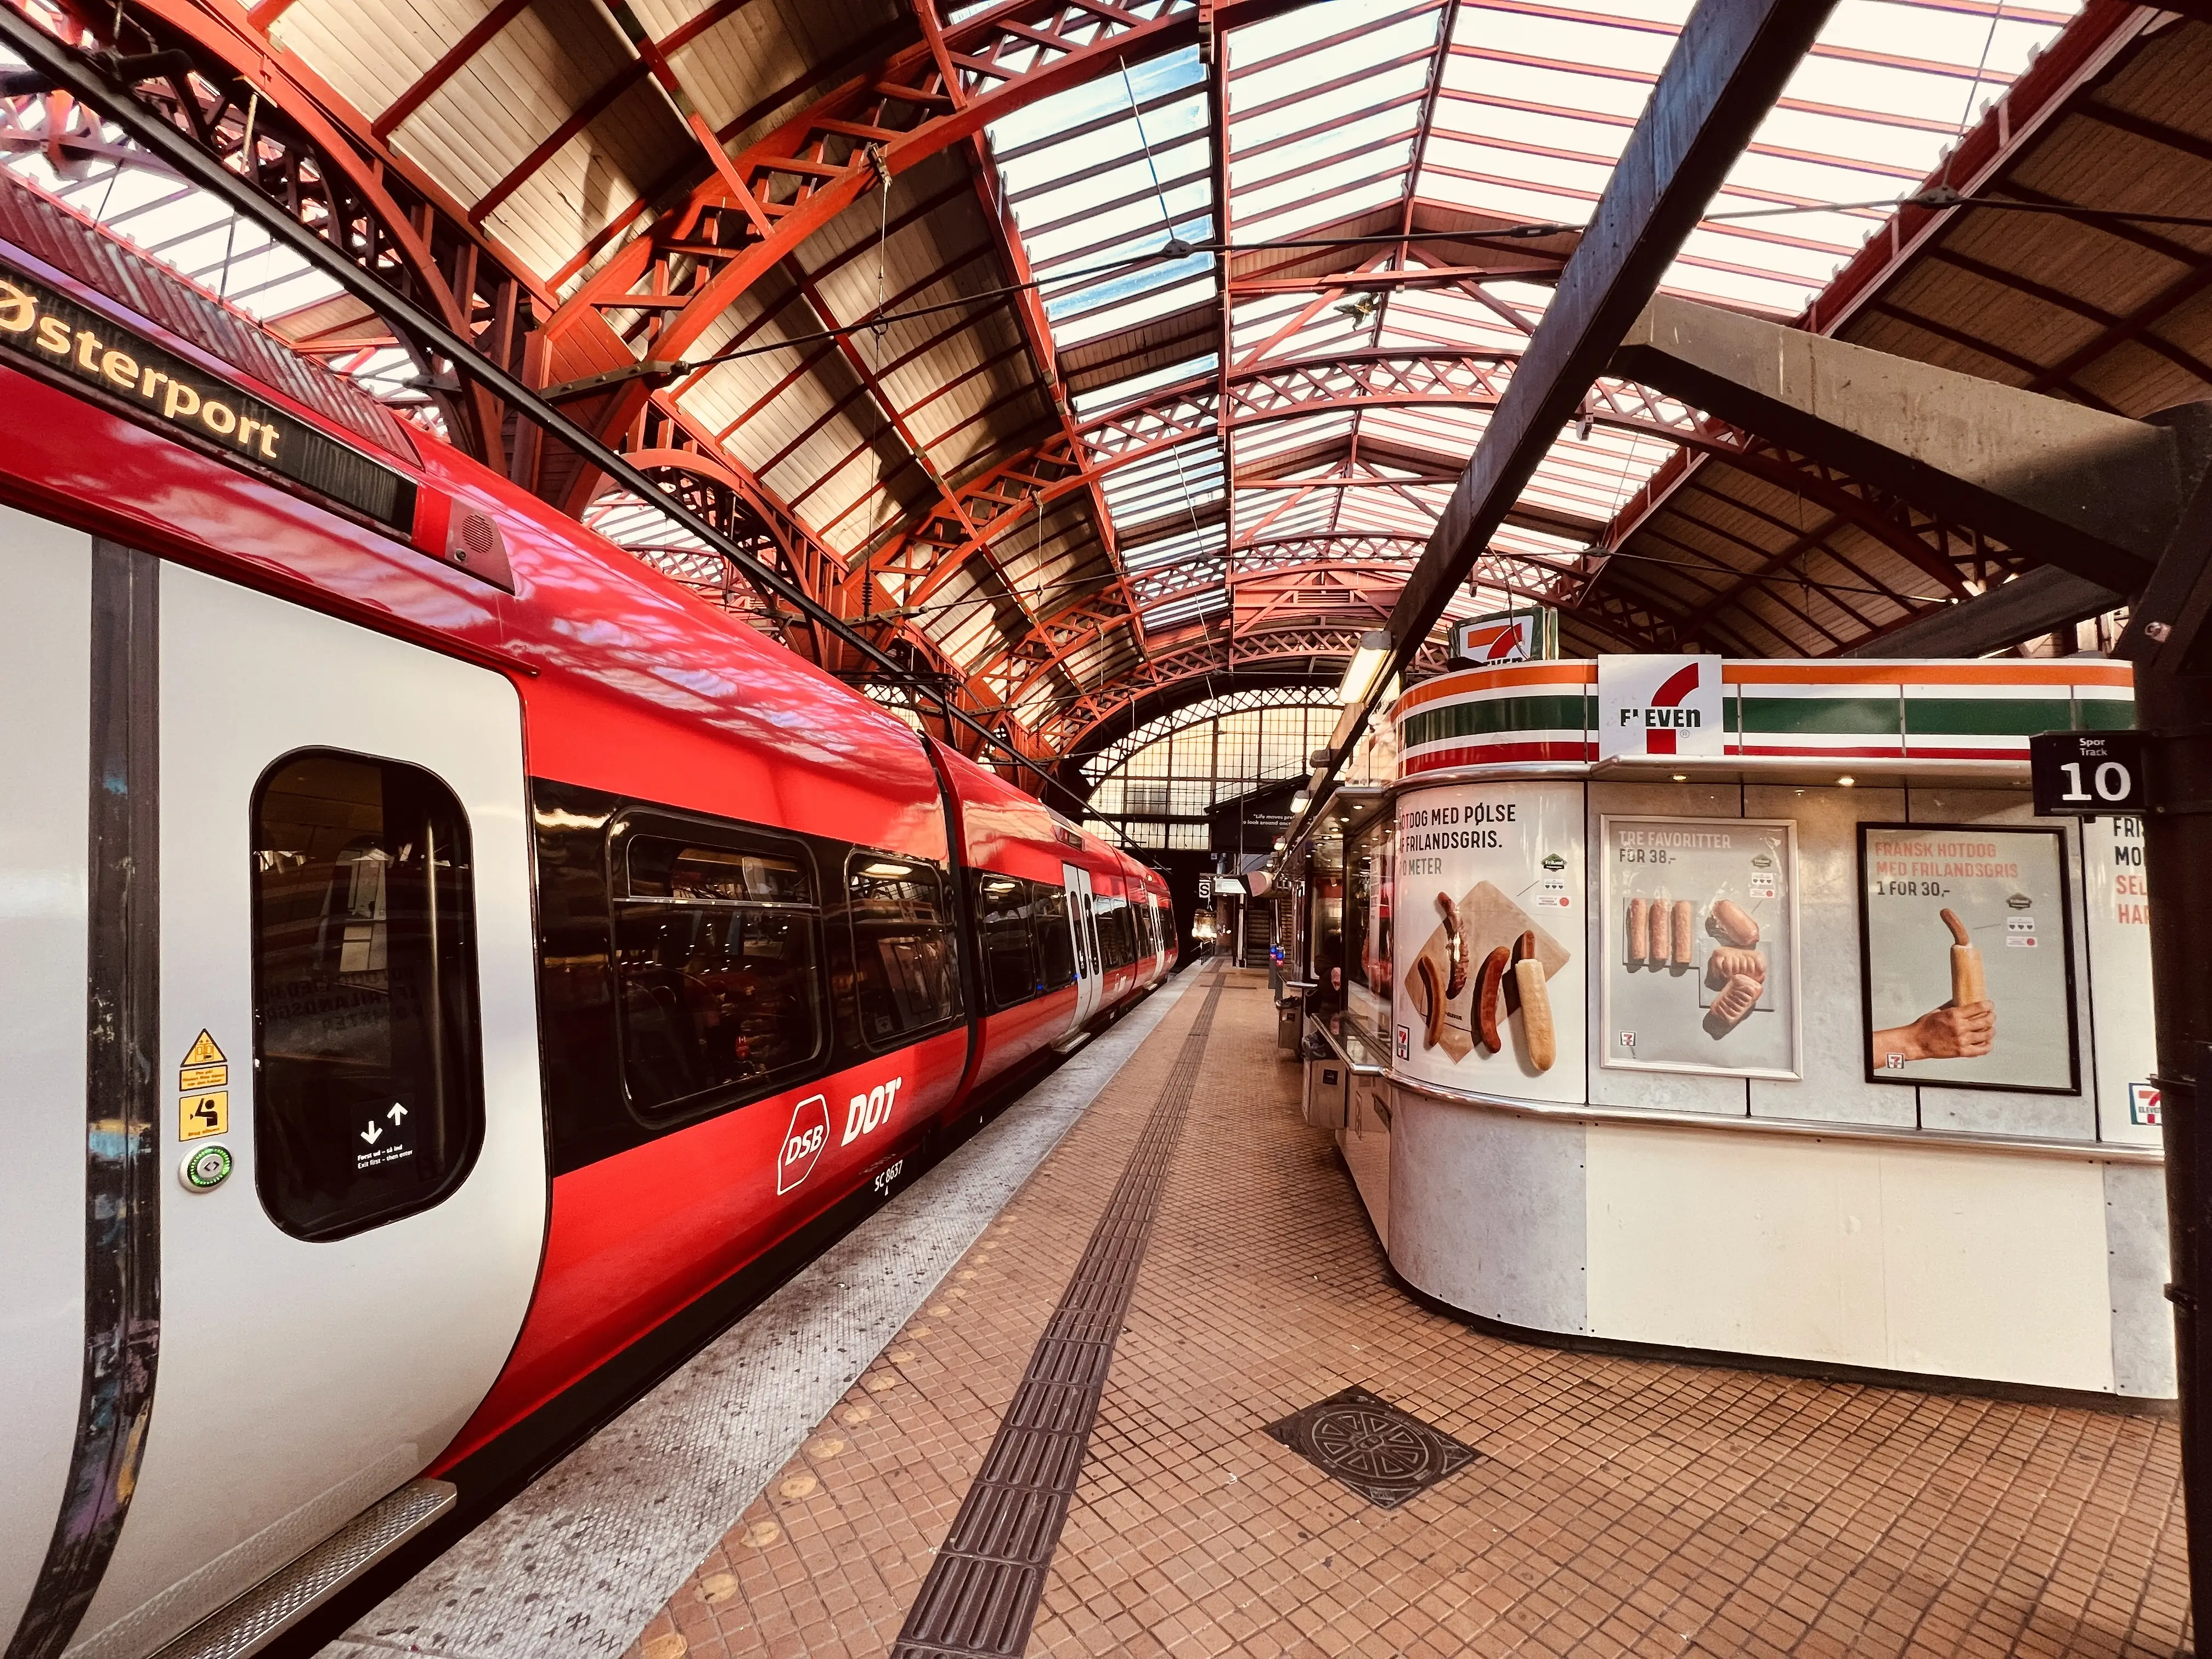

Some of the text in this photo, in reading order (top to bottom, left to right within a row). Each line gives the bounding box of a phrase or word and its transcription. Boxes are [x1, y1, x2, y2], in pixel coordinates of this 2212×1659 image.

[2079, 737, 2106, 747] Spor
[2079, 748, 2108, 757] Track
[2061, 761, 2131, 801] 10
[1431, 807, 1459, 826] MED
[1464, 802, 1516, 826] PØLSE
[1406, 830, 1503, 853] FRILANDSGRIS.
[1618, 831, 1731, 849] TRE FAVORITTER
[1620, 848, 1677, 865] FOR 38,-
[1875, 841, 1997, 858] FRANSK HOTDOG
[2114, 845, 2144, 866] MO
[1408, 857, 1442, 876] METER
[1876, 861, 2018, 878] MED FRILANDSGRIS
[1200, 884, 1209, 895] S
[1876, 881, 1950, 898] 1 FOR 30,-
[785, 1076, 902, 1166] DSB DOT
[874, 1159, 903, 1192] SC 8637
